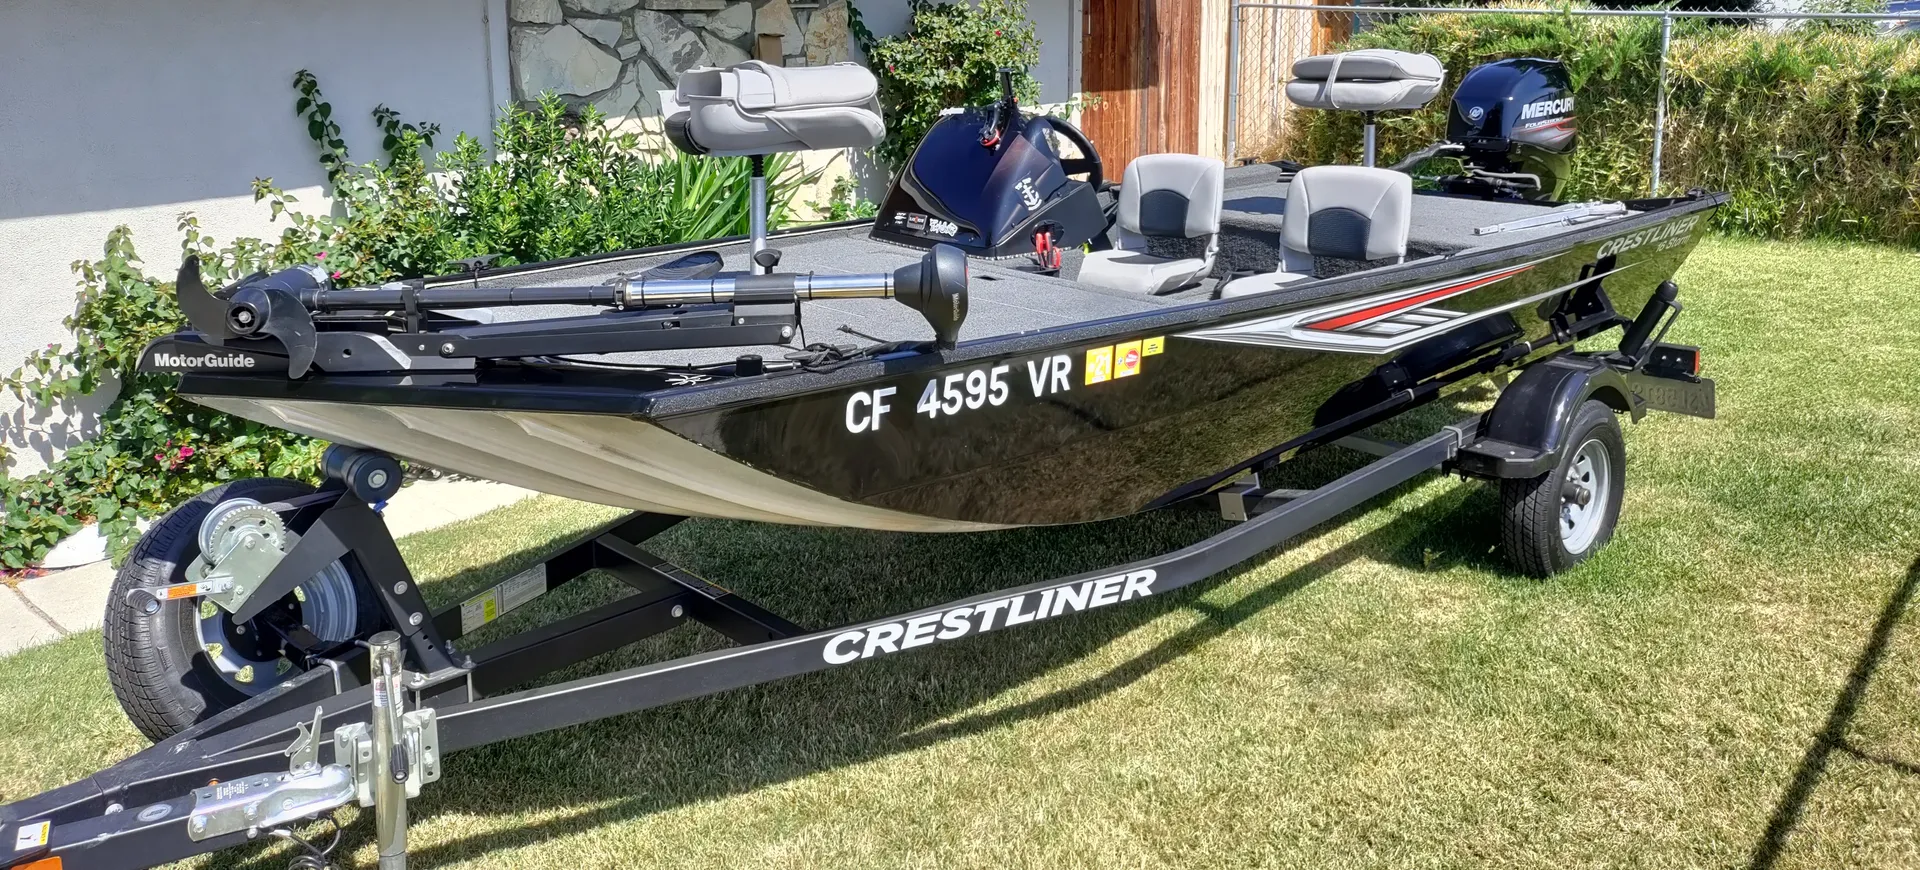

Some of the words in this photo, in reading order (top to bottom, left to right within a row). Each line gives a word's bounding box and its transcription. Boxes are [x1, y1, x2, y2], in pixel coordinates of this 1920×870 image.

[1521, 96, 1575, 120] MERCURY
[1596, 215, 1700, 260] CRESTLINER
[154, 353, 255, 368] MotorGuide
[845, 386, 897, 434] CF
[916, 364, 1009, 419] 4595
[1027, 354, 1072, 398] VR
[822, 568, 1157, 665] CRESTLINER
